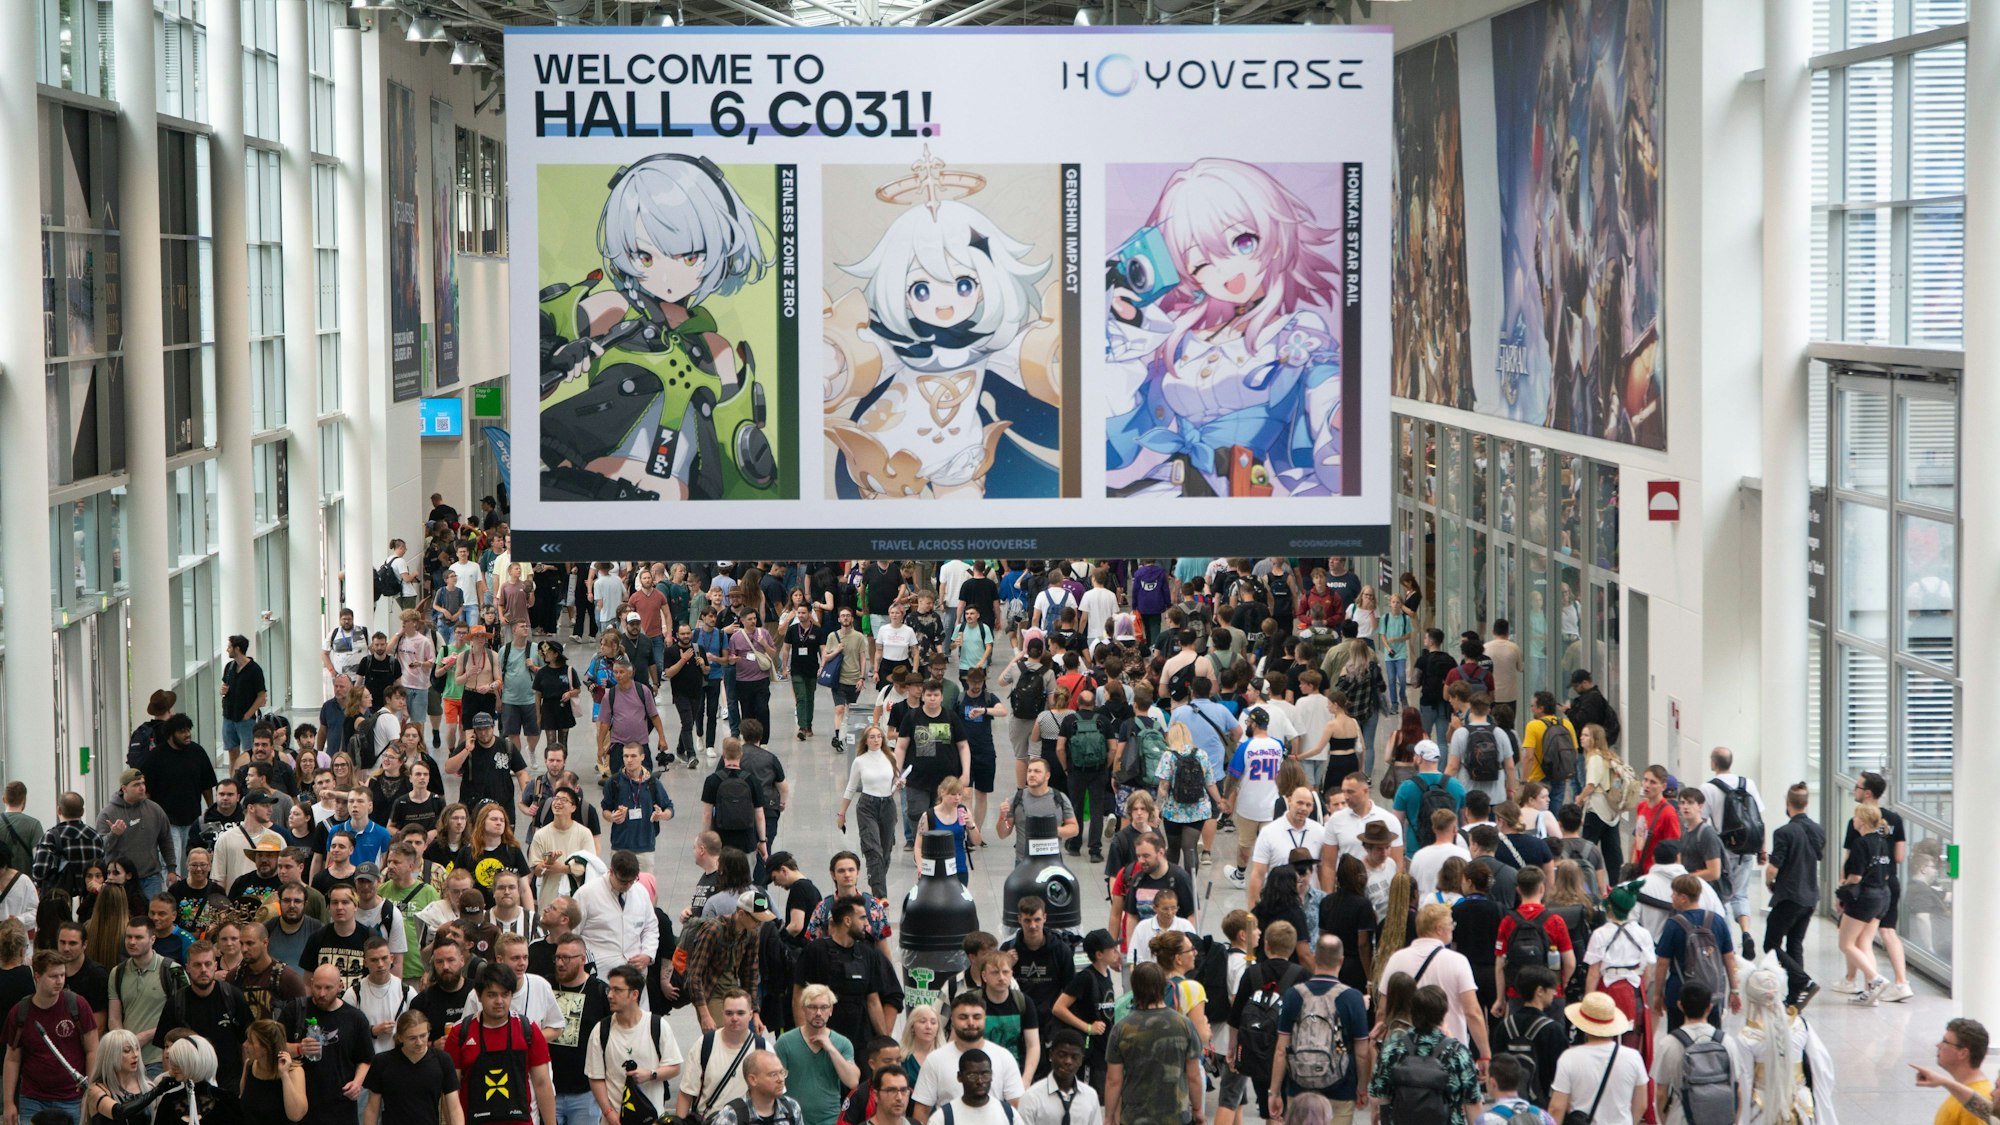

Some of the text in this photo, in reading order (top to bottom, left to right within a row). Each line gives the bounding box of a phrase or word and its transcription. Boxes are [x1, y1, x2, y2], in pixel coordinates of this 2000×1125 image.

[534, 54, 825, 84] WELCOME TO
[1062, 53, 1364, 98] HOYOVERSE
[535, 90, 694, 137] HALL
[781, 168, 796, 319] ZENLESS ZONE ZERO
[1065, 168, 1078, 294] GENSHIN IMPACT
[1346, 166, 1359, 306] HONKAI: STAR RAIL
[871, 538, 1038, 551] TRAVEL ACROSS HOYOVERSE
